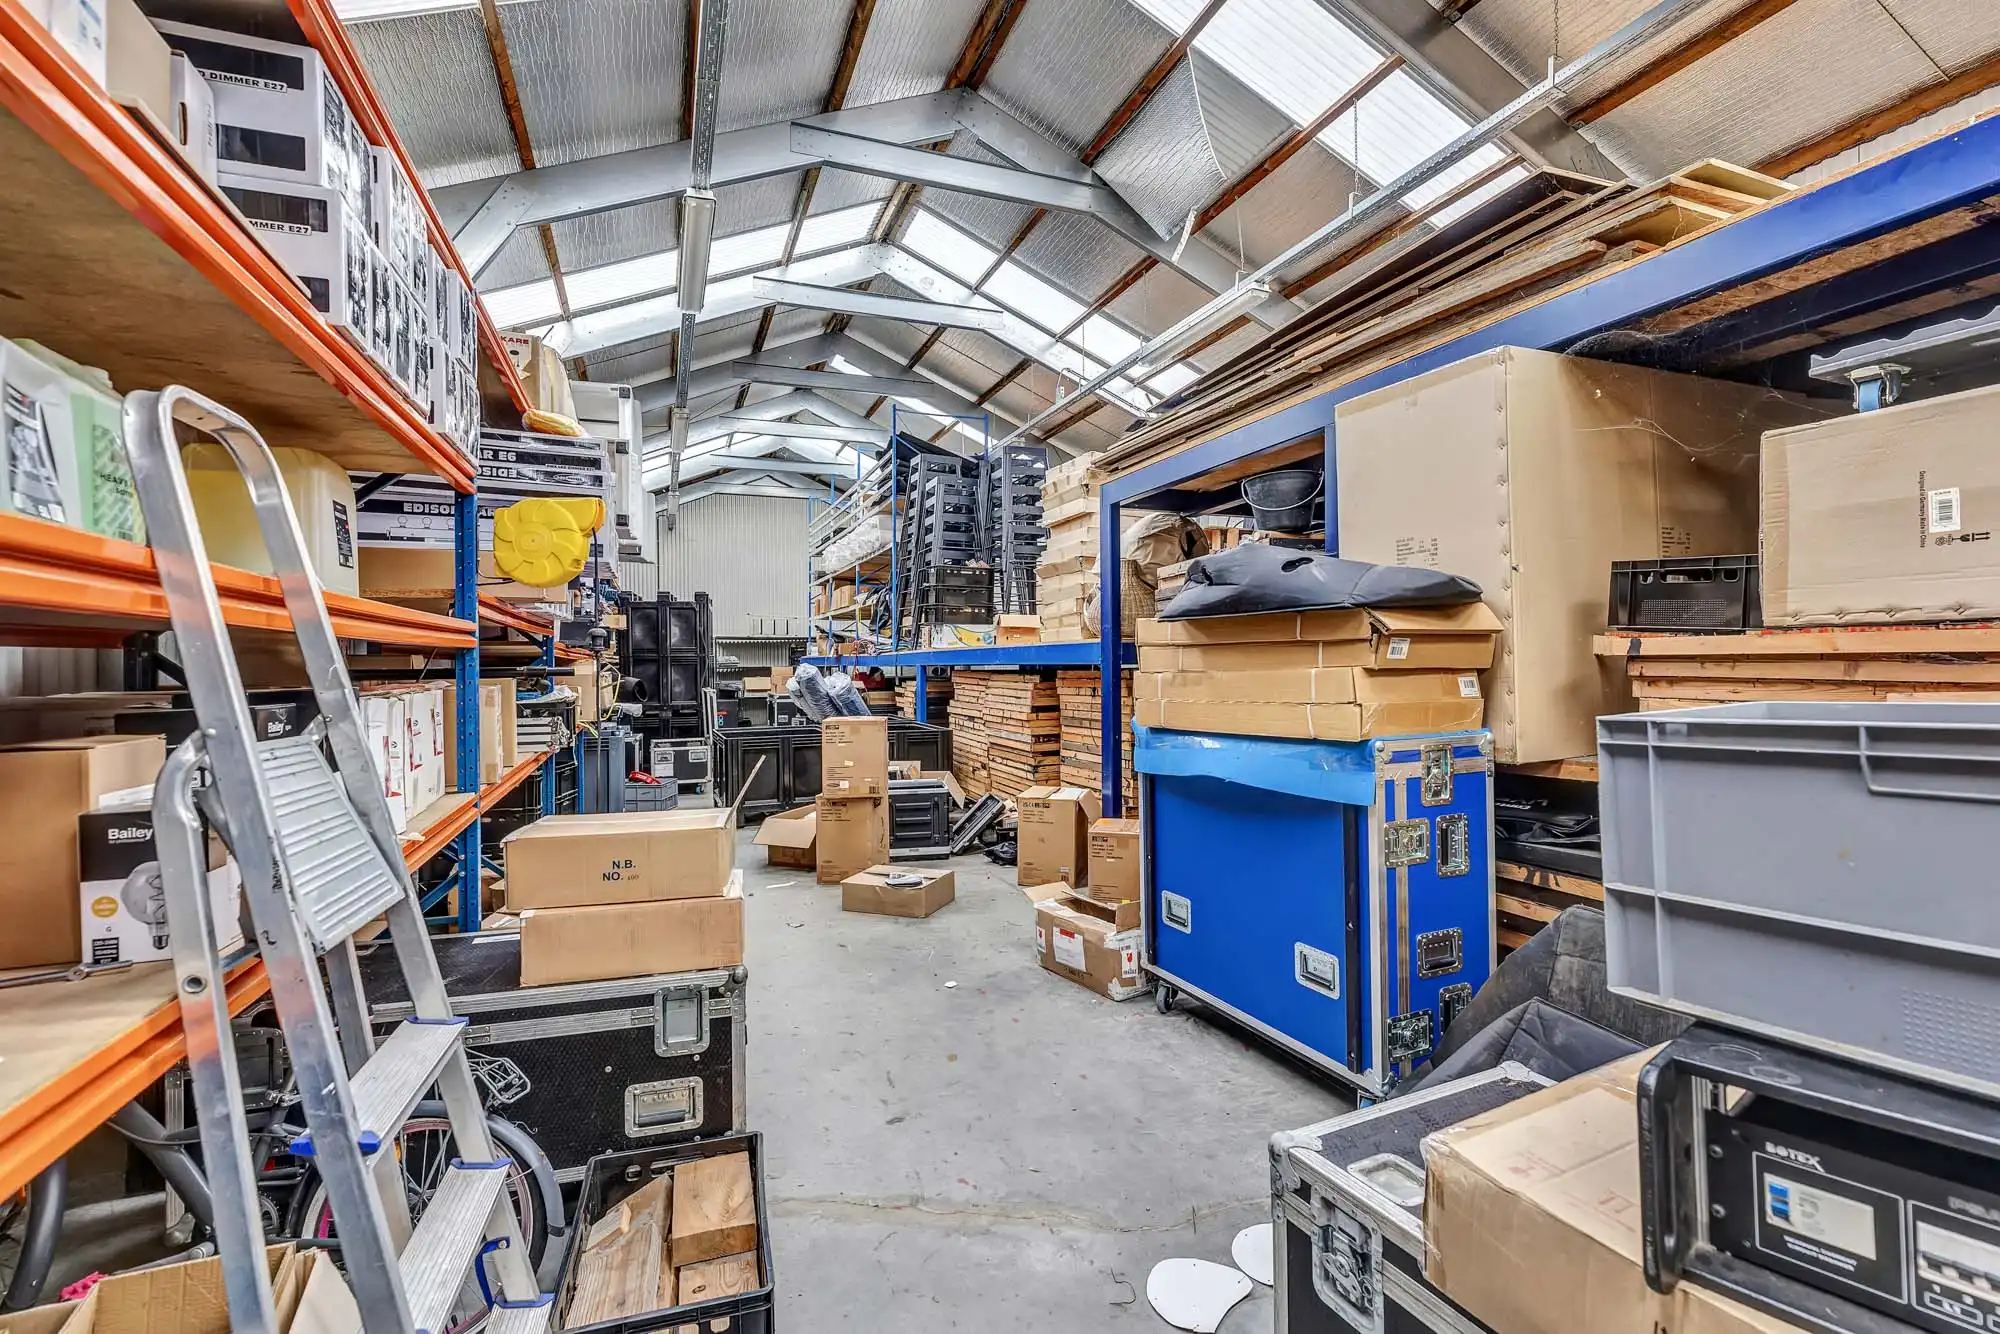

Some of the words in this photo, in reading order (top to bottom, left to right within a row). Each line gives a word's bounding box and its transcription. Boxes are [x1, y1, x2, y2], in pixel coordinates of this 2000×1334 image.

[209, 72, 260, 87] DIMMER
[263, 81, 285, 91] E27
[249, 220, 285, 231] MMER
[288, 225, 310, 234] E27
[477, 449, 496, 460] AR
[498, 451, 517, 462] E6
[403, 502, 455, 515] EDISO
[107, 827, 153, 841] Bailey
[612, 859, 637, 870] N.B.
[602, 871, 624, 882] NO.
